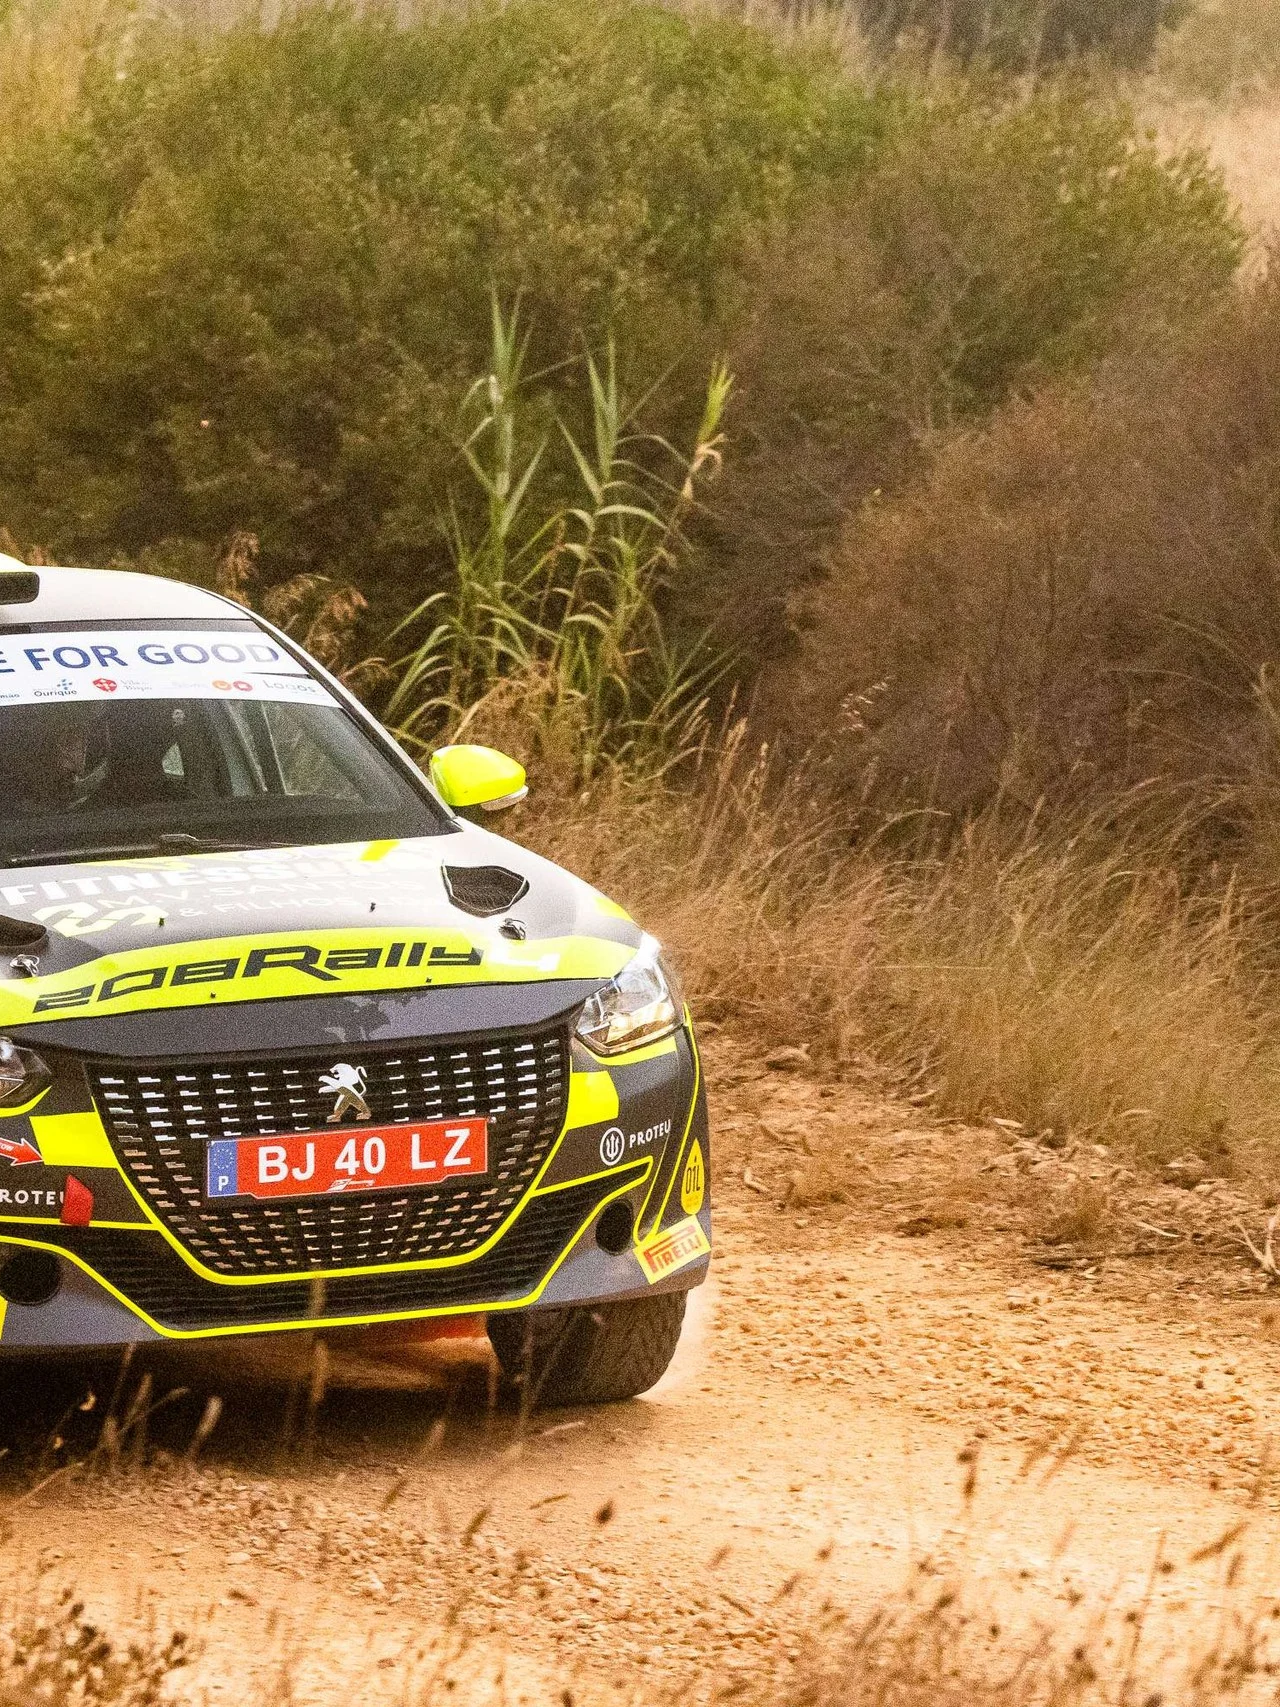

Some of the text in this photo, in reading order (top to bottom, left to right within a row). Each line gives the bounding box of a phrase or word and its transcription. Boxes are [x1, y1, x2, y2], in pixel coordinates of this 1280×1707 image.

[23, 645, 128, 671] FOR
[137, 643, 279, 667] GOOD
[33, 688, 78, 699] Ourique
[257, 1128, 471, 1184] BJ 40 LZ
[218, 1175, 229, 1191] P
